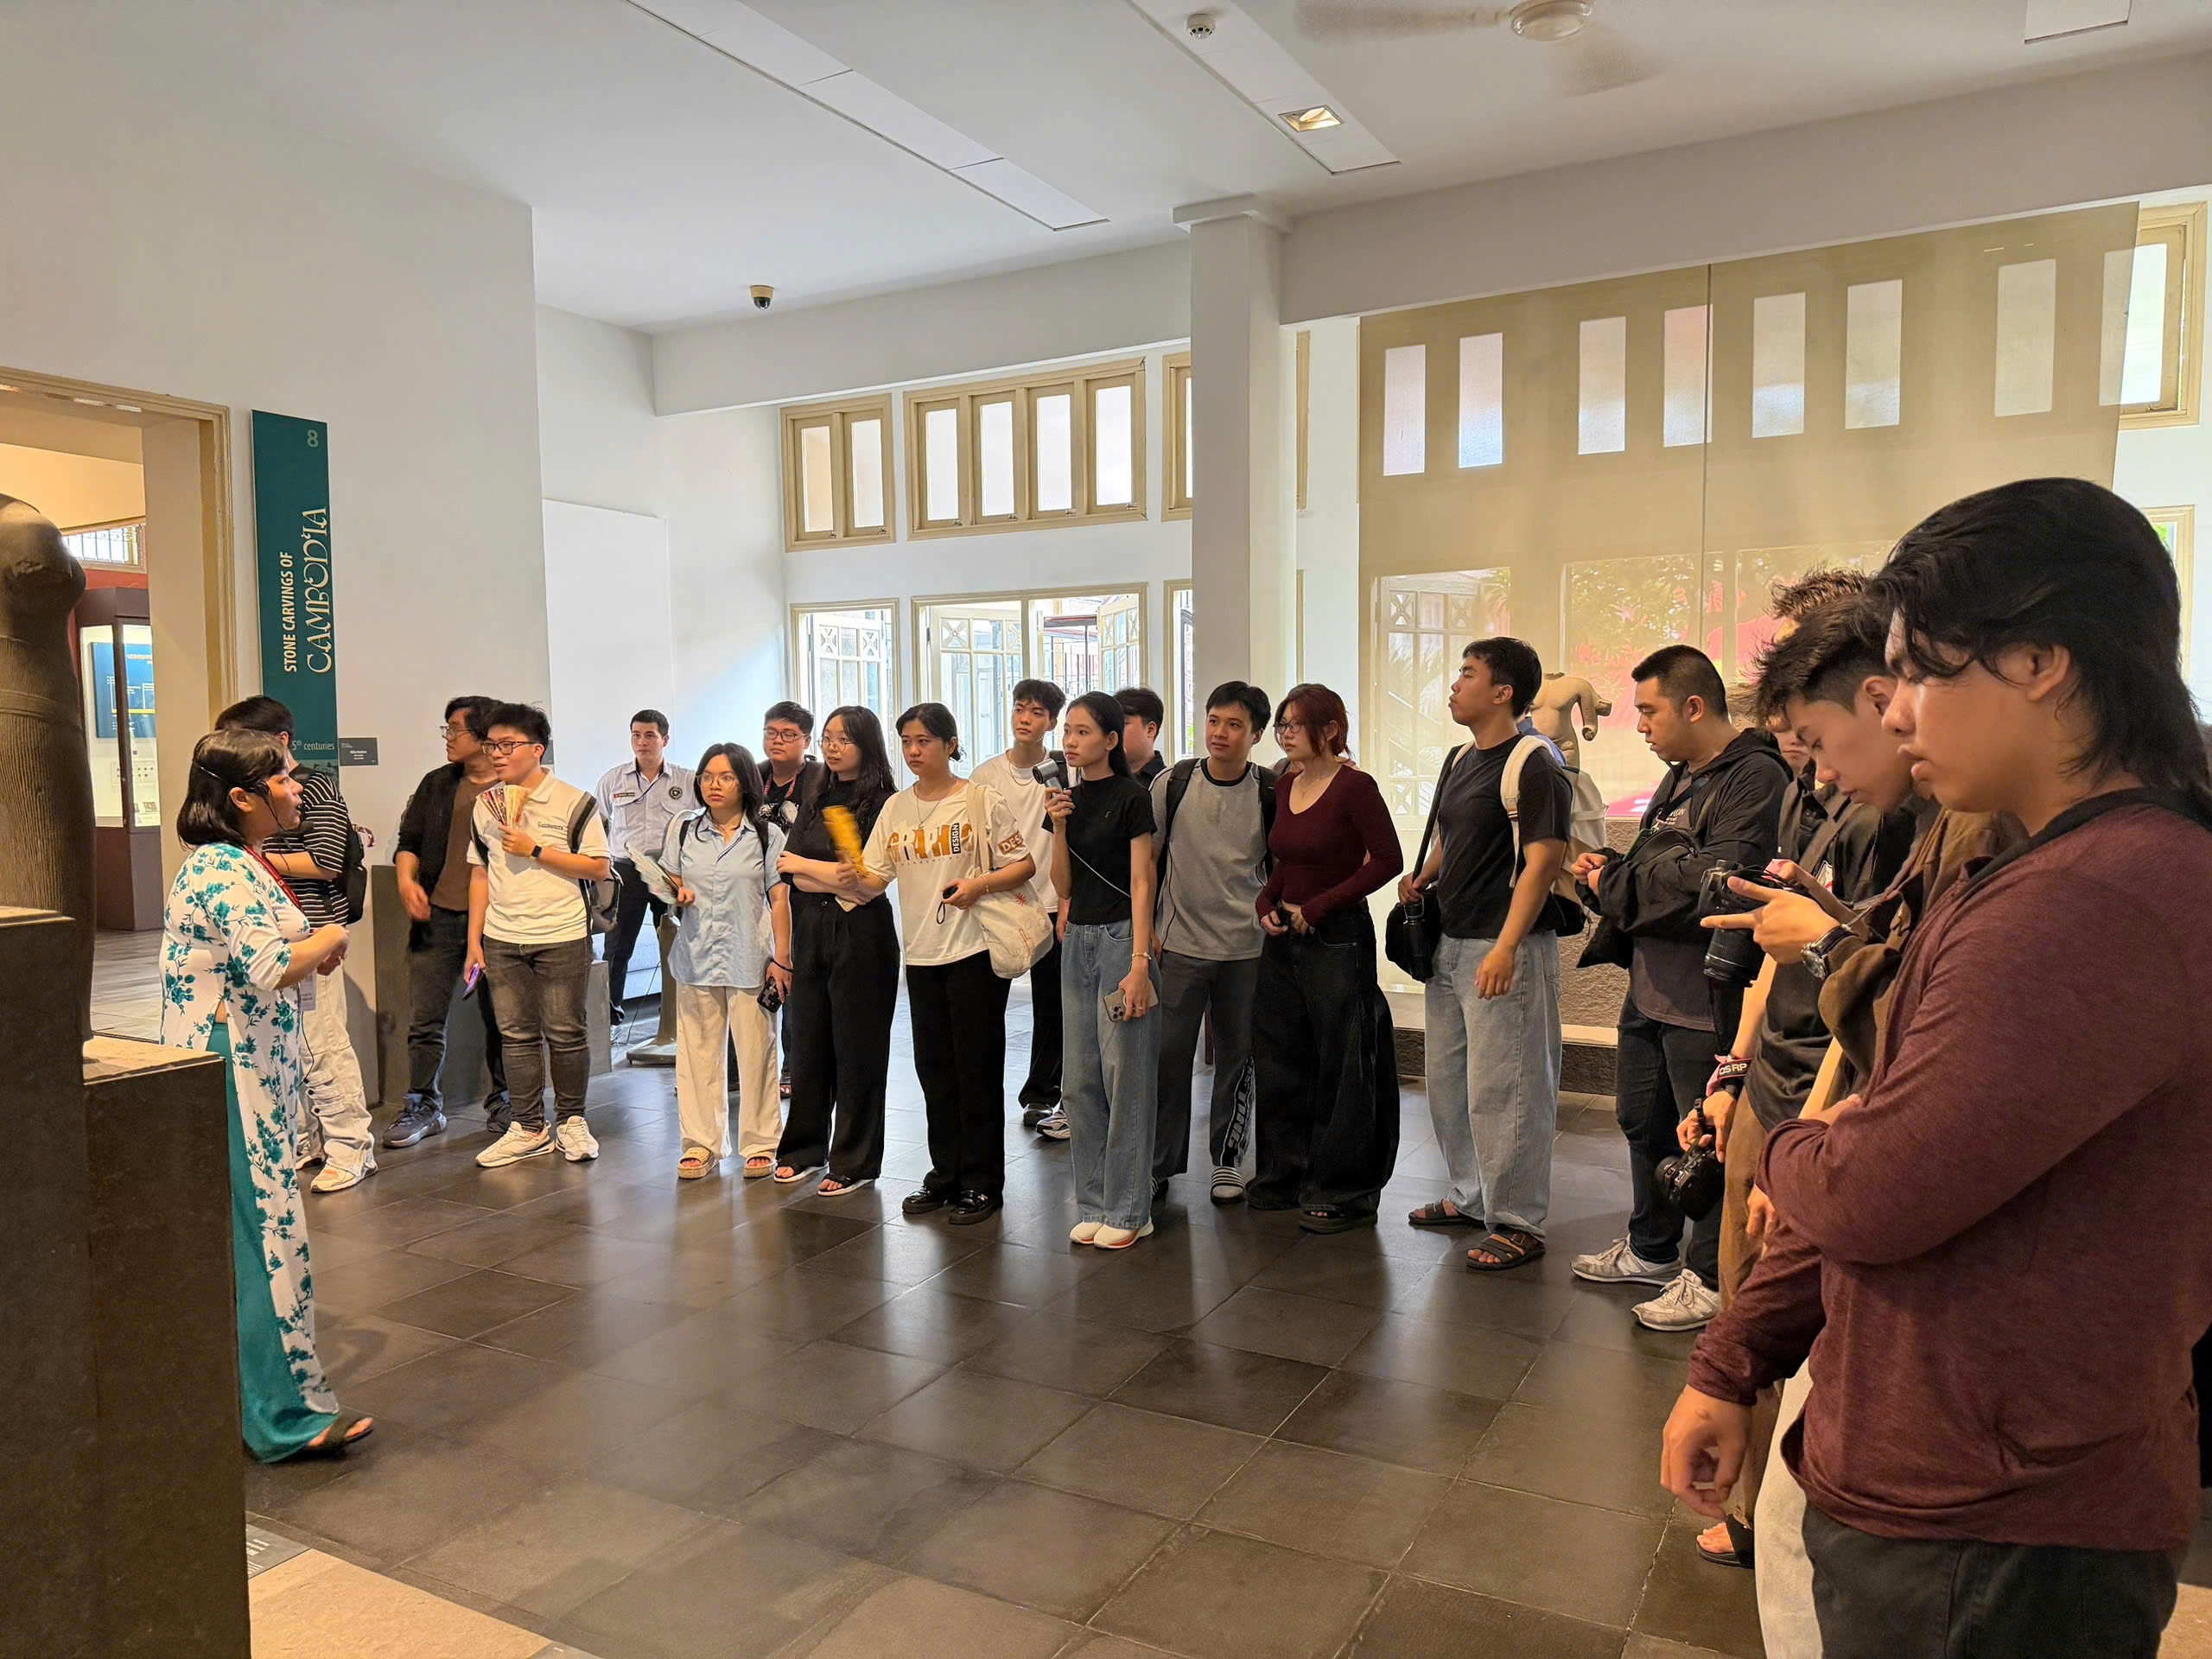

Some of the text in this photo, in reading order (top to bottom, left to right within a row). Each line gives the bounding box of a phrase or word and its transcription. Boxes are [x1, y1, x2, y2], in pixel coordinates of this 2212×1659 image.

[307, 429, 319, 448] 8
[301, 505, 332, 673] CAMBODIA
[280, 551, 297, 673] STONE CARVINGS OF
[303, 741, 335, 751] centuries
[951, 823, 961, 853] DESIGN
